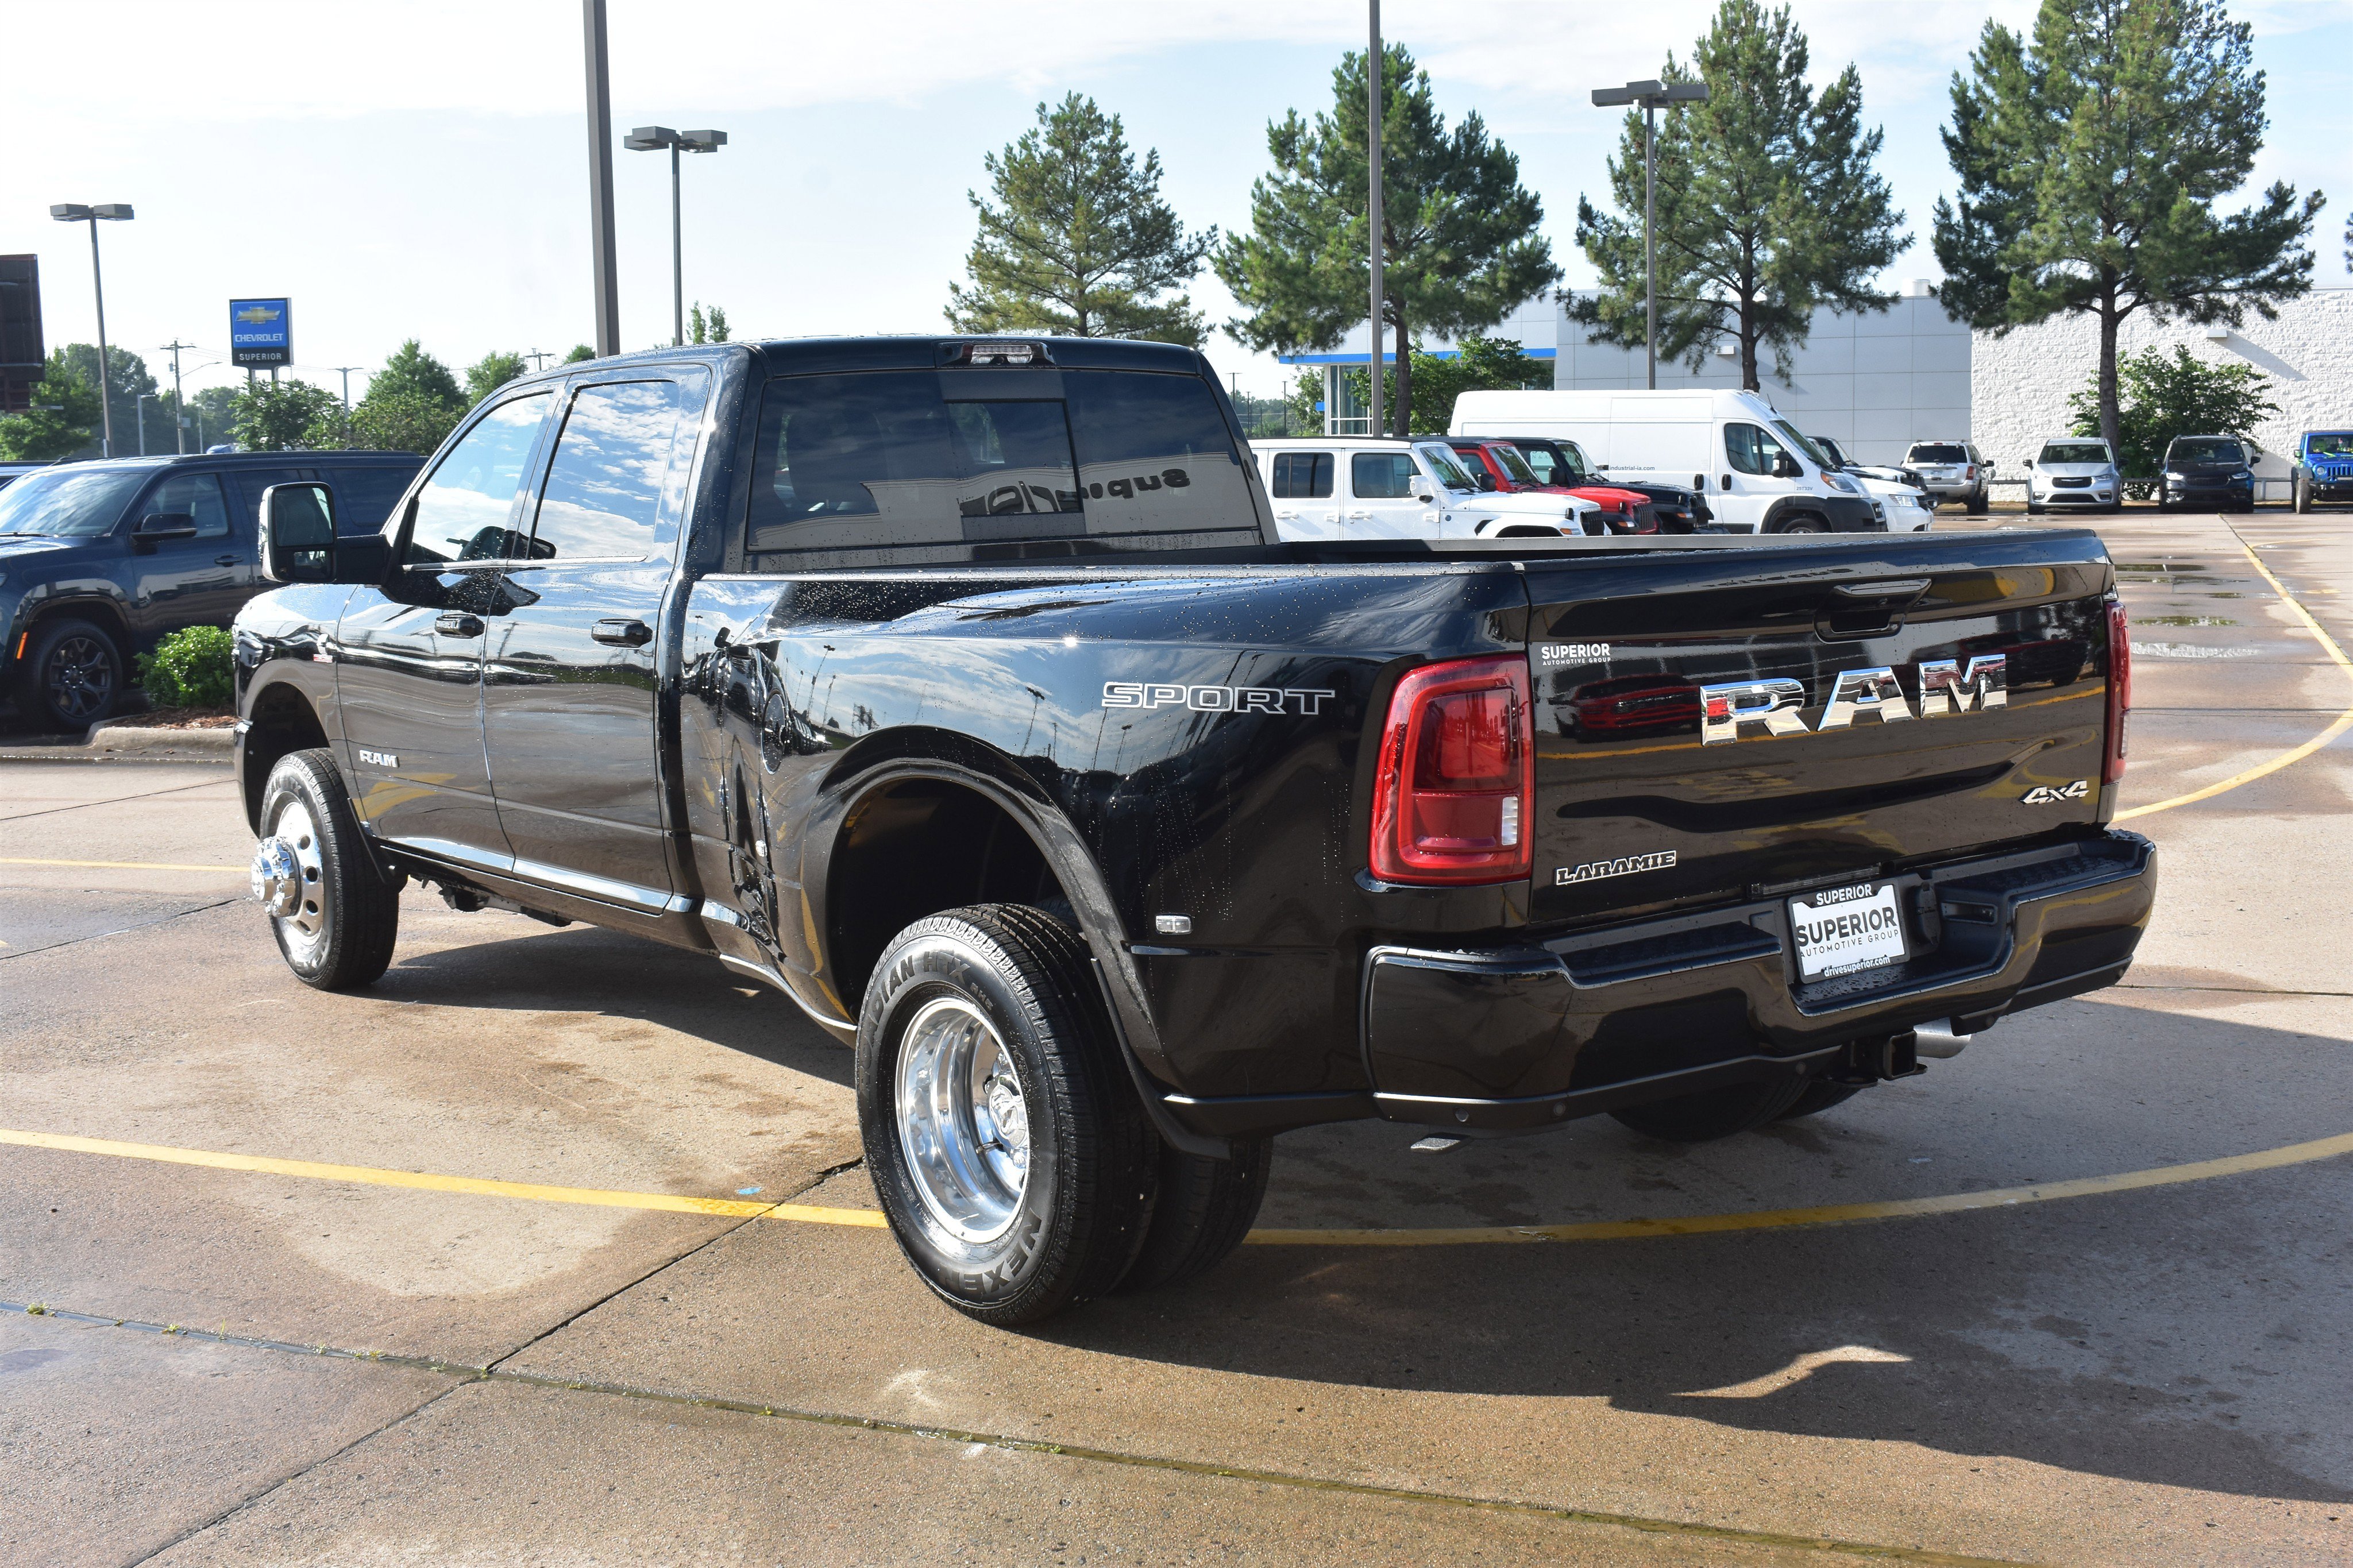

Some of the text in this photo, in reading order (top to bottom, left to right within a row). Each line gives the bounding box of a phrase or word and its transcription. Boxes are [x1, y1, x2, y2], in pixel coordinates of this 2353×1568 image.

[235, 333, 283, 342] CHEVROLET
[1541, 643, 1610, 659] SUPERIOR
[1102, 681, 1335, 715] SPORT
[1700, 654, 2007, 746] RAM
[359, 750, 398, 767] RAM
[1554, 850, 1676, 885] LARAMIE
[1816, 884, 1872, 905] SUPERIOR
[1796, 906, 1897, 947] SUPERIOR
[1800, 929, 1899, 957] AUTOMOTIVE GROUP
[923, 951, 971, 985] HTX
[1824, 956, 1891, 977] drivesuperior.com
